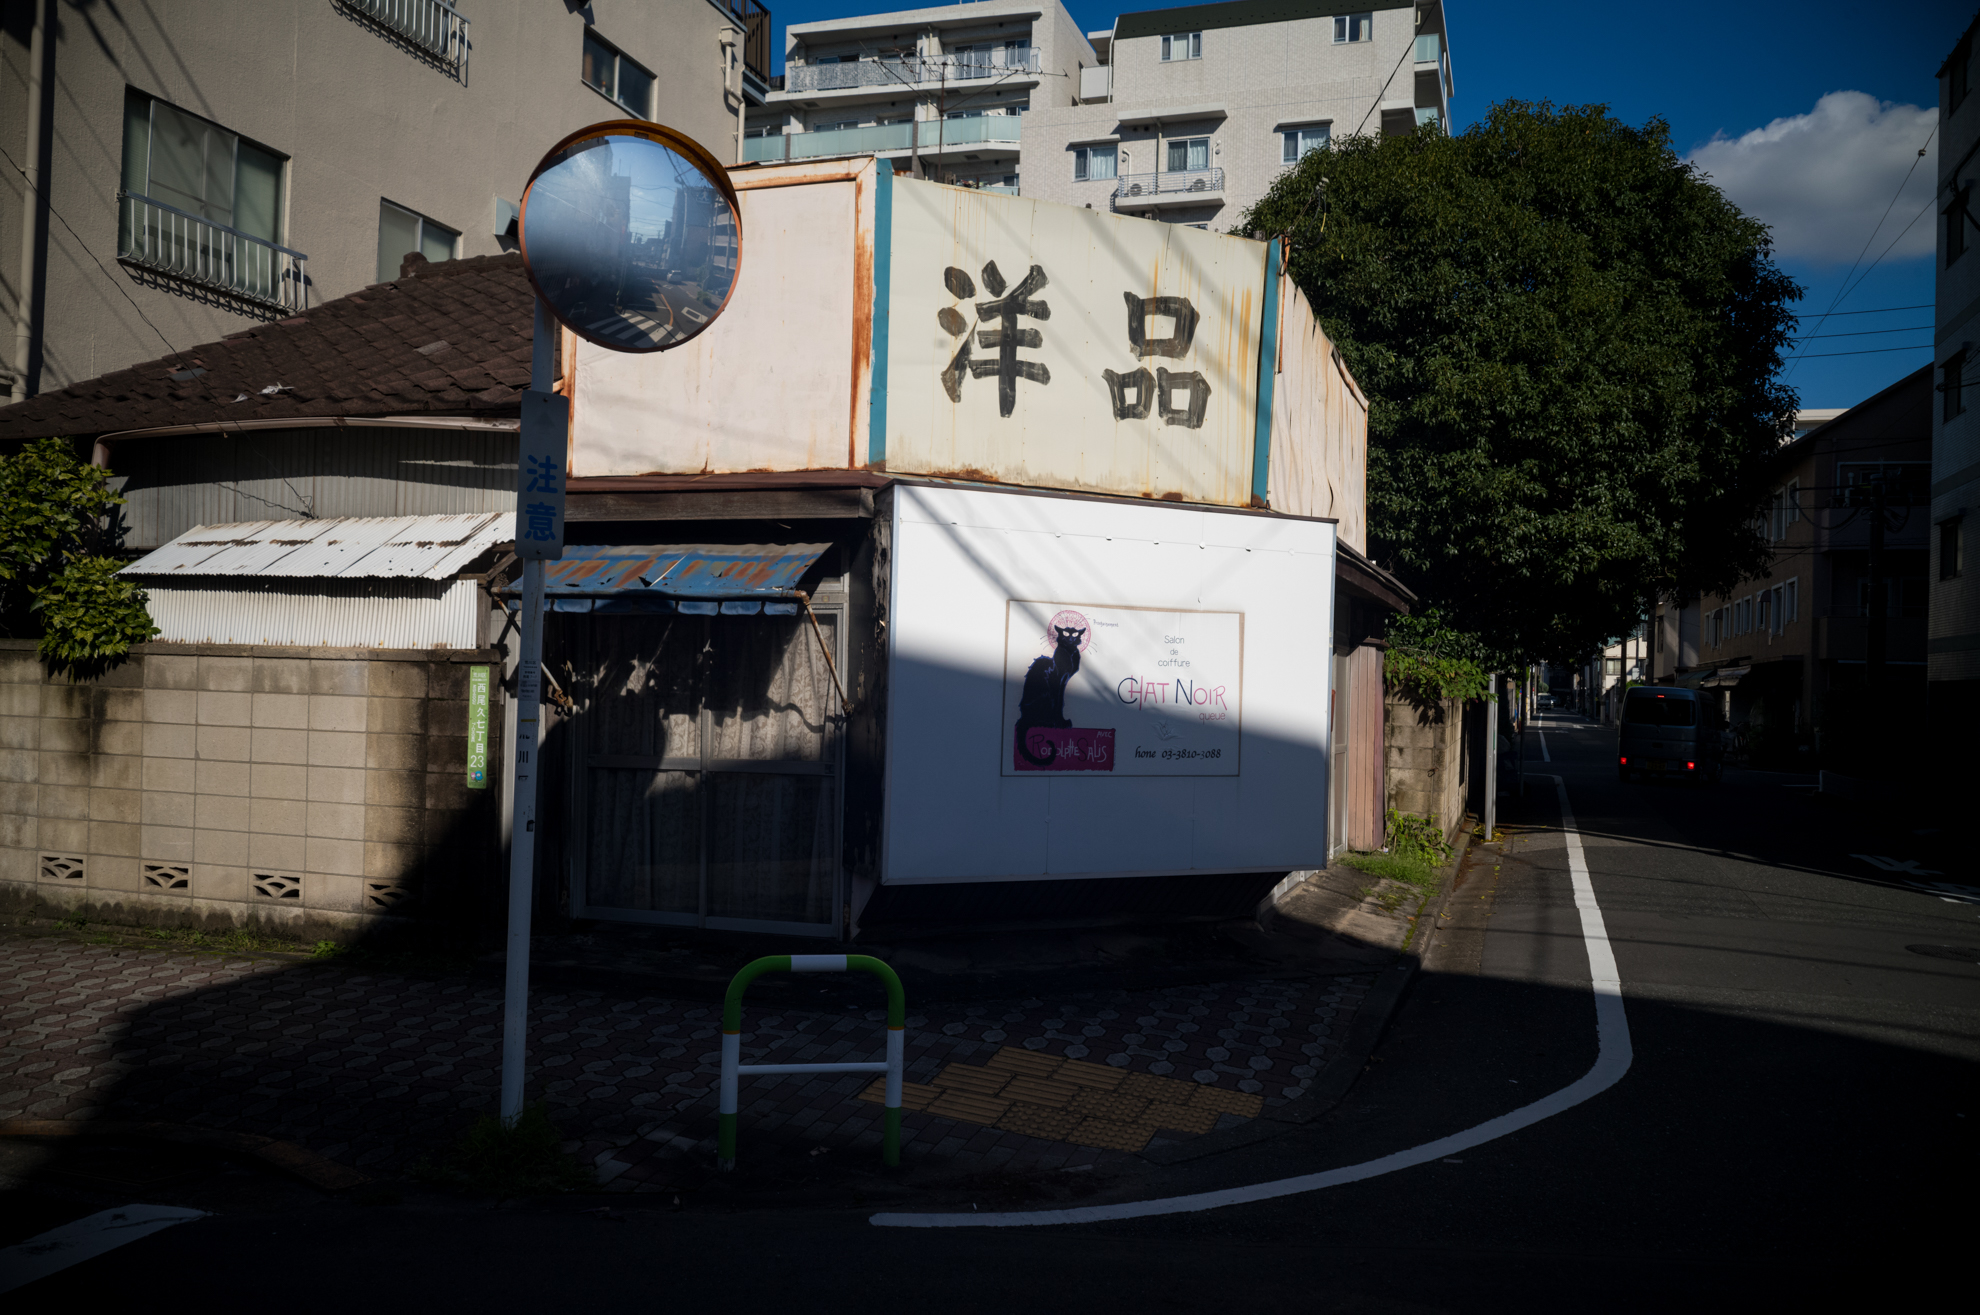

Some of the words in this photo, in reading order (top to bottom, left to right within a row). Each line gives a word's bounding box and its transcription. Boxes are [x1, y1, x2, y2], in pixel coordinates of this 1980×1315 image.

[937, 259, 1212, 429] 洋品
[524, 454, 558, 542] 注意
[1164, 635, 1185, 644] Salon
[1157, 658, 1190, 667] coiffure
[1118, 675, 1169, 711] CHAT
[1175, 678, 1227, 711] NOIR
[1199, 711, 1226, 725] queue
[1161, 748, 1222, 760] 03-3810-3088
[470, 755, 484, 768] 23
